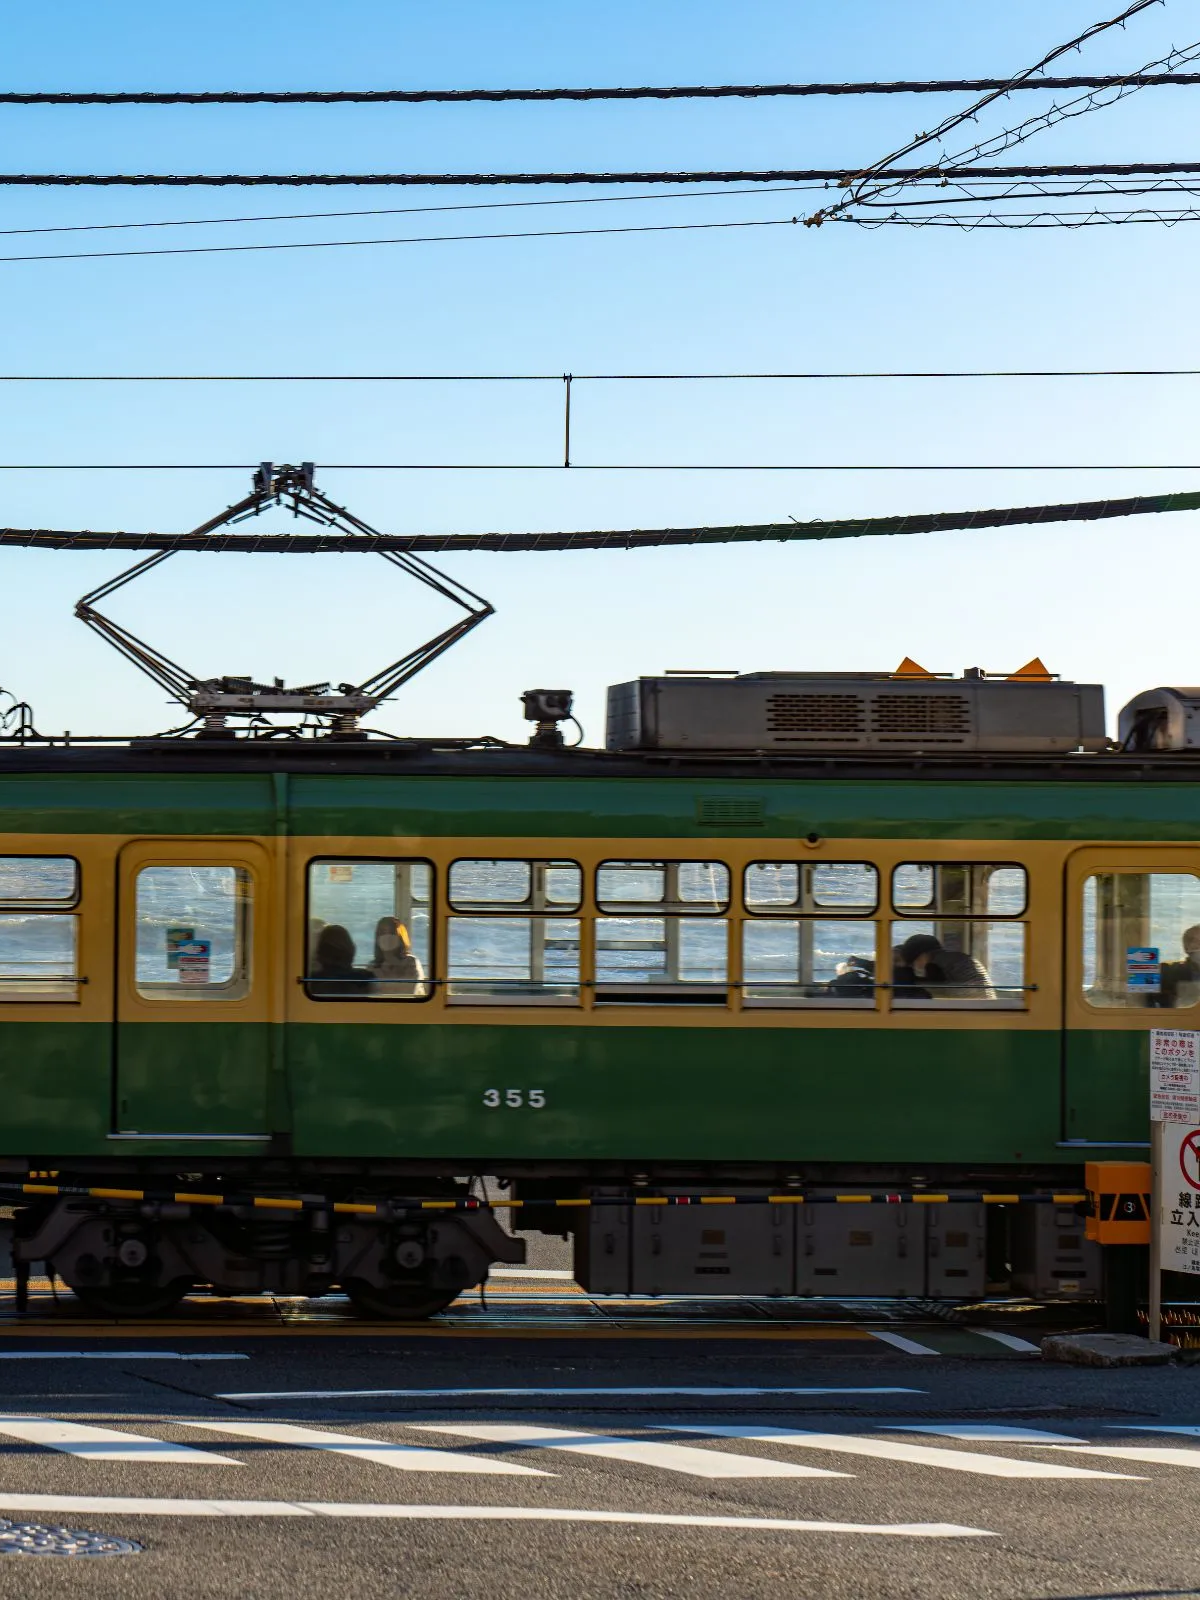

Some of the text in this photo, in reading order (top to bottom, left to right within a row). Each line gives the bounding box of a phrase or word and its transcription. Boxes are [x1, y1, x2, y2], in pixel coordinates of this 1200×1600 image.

[1155, 1047, 1195, 1058] このボタンを
[482, 1089, 547, 1108] 355
[1170, 1209, 1200, 1227] 立入
